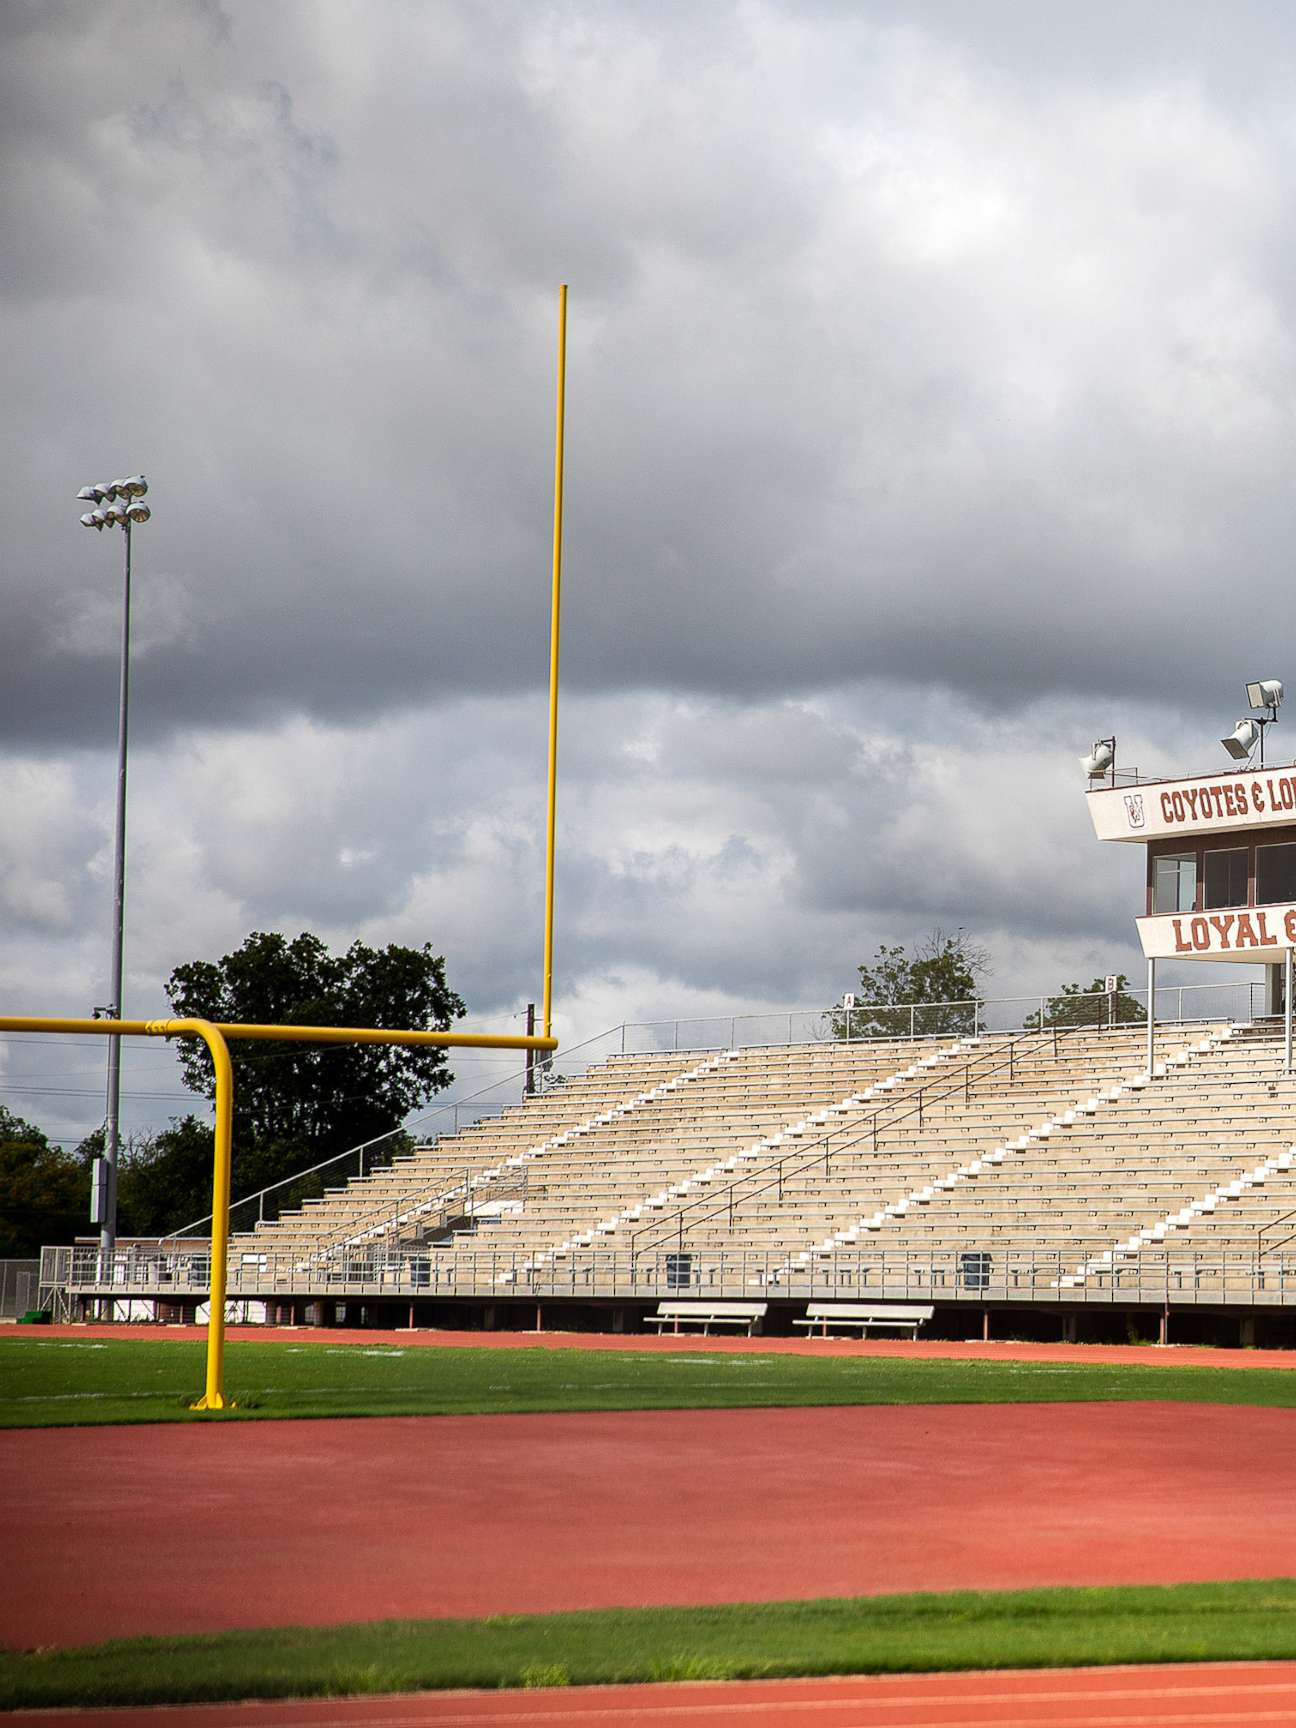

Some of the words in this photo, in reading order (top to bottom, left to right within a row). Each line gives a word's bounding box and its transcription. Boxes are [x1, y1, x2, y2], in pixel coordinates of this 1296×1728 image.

[1160, 784, 1249, 823] COYOTES
[1251, 782, 1265, 813] &
[1172, 912, 1278, 952] LOYAL
